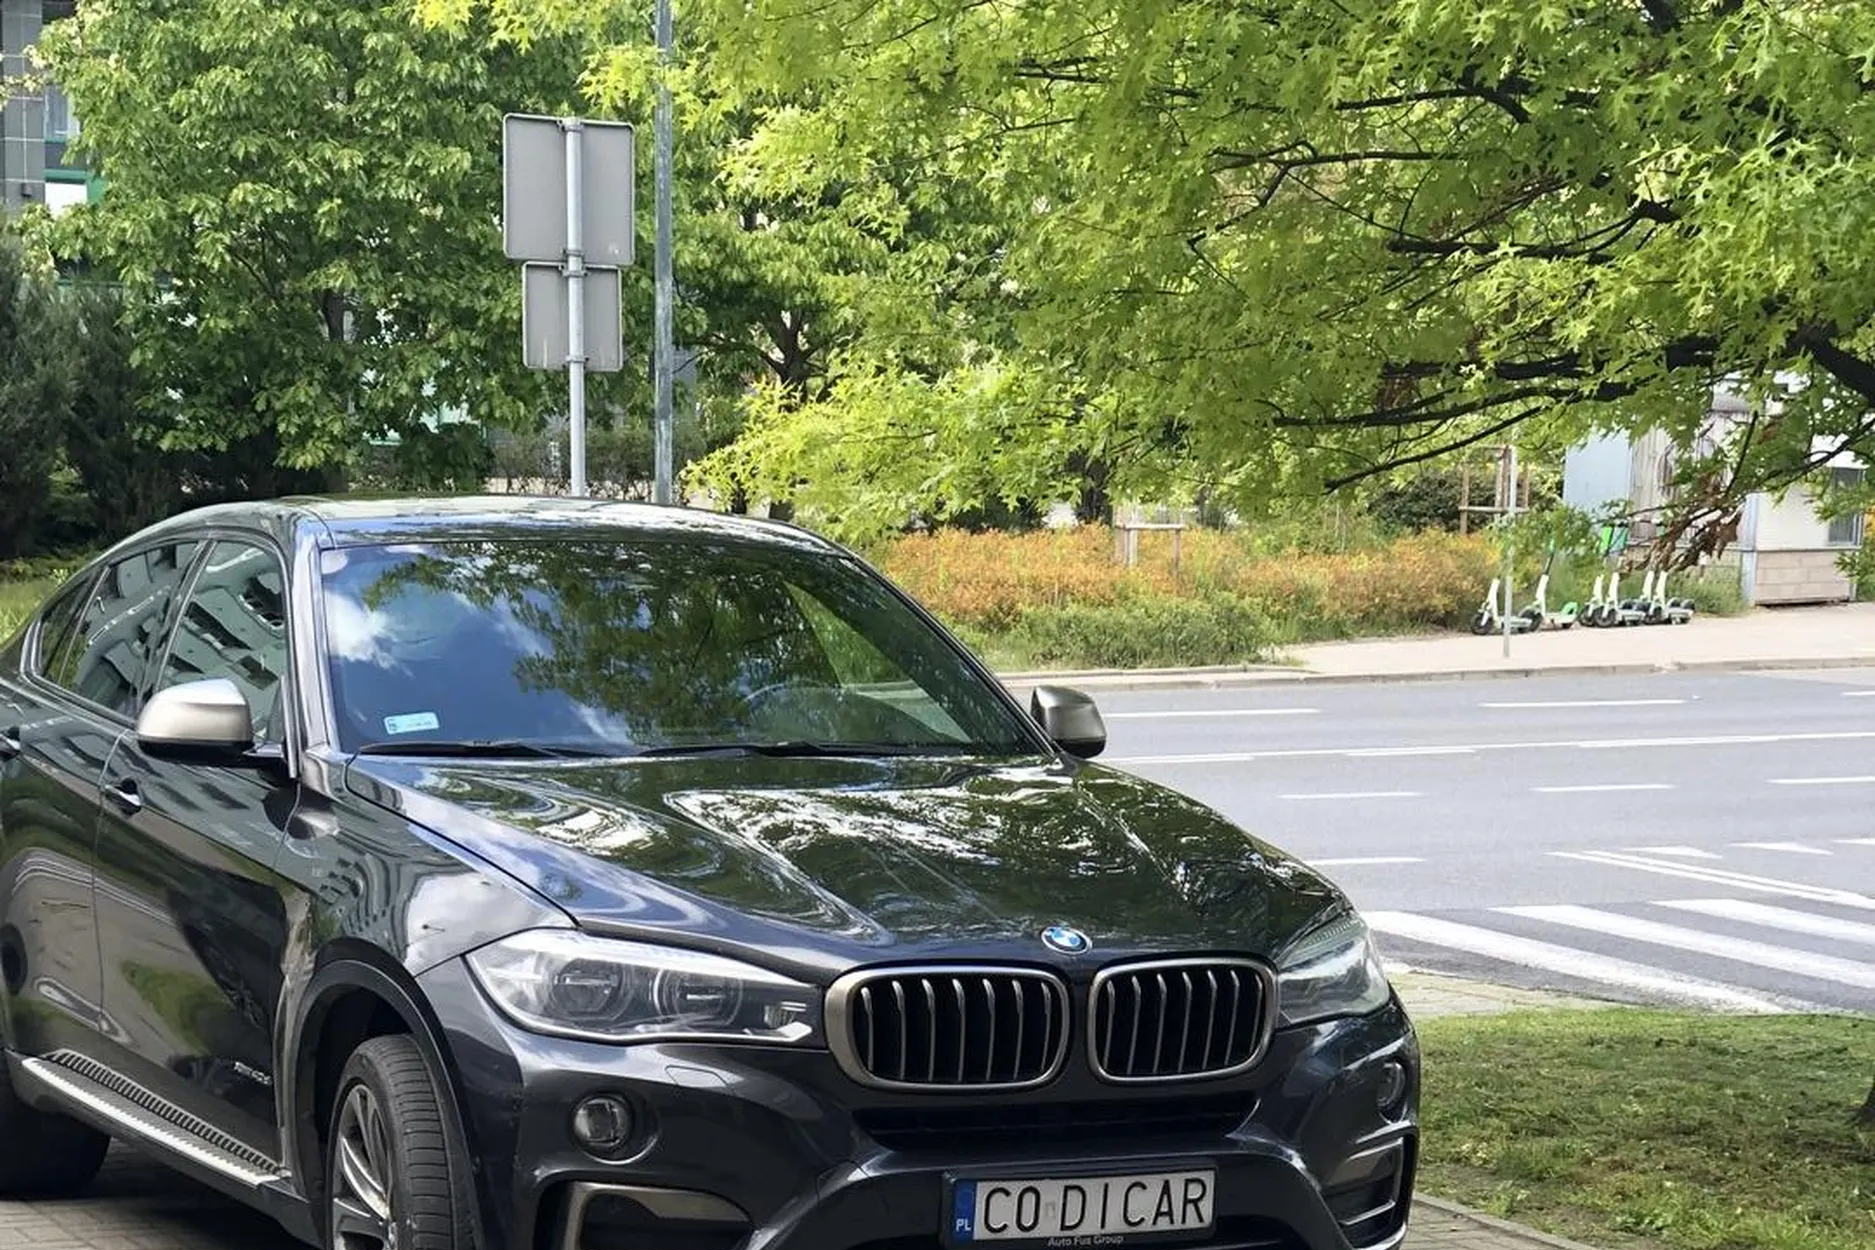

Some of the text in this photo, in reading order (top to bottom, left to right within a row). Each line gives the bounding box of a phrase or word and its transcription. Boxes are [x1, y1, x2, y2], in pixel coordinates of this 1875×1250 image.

[1060, 1178, 1207, 1232] DICAR
[956, 1219, 971, 1232] PL
[1047, 1236, 1072, 1247] Auto
[1094, 1234, 1125, 1245] Group
